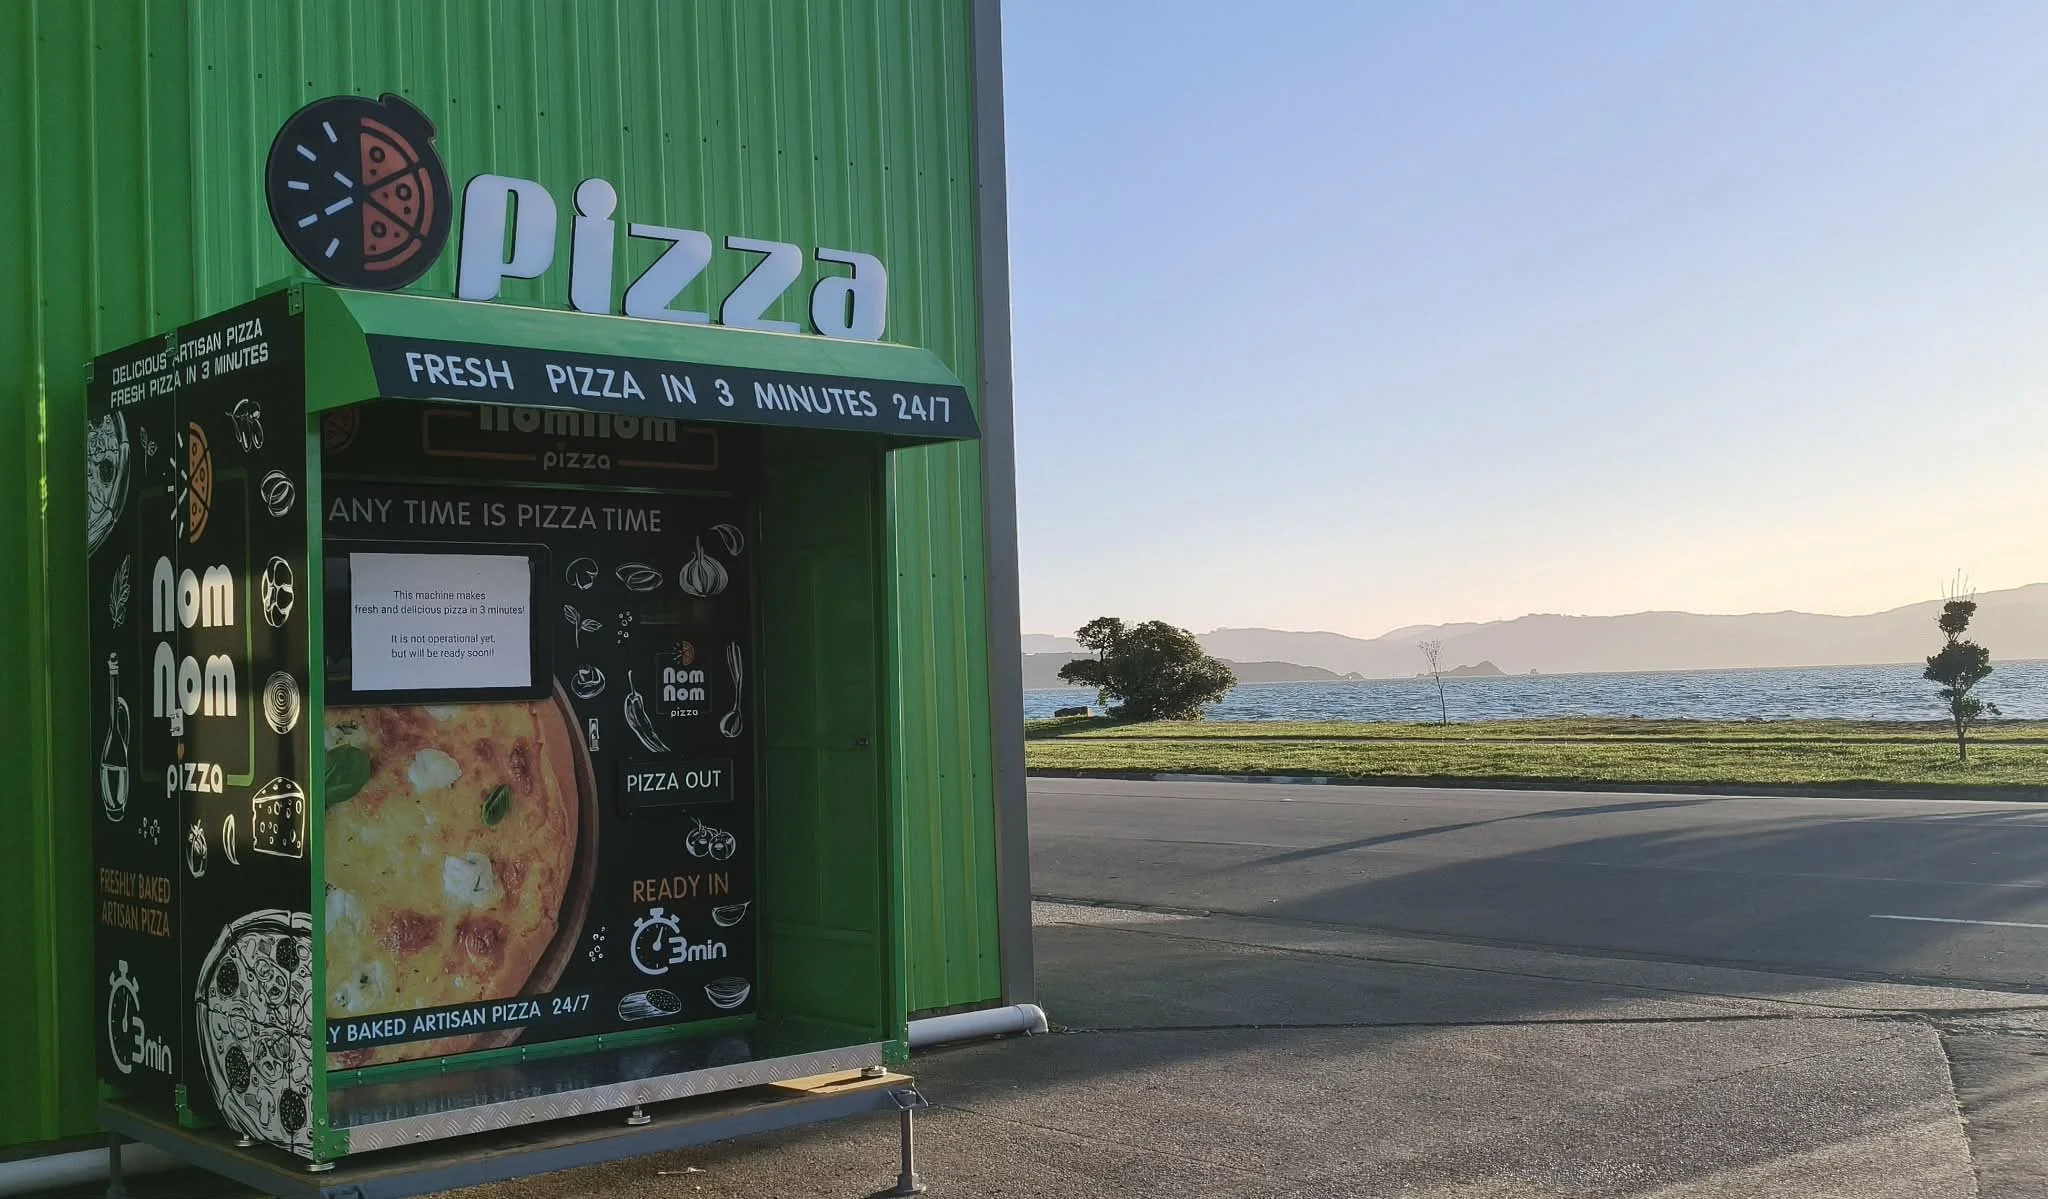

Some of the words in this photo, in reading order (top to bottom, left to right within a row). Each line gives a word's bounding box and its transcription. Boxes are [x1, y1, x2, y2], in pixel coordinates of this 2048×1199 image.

[454, 174, 887, 341] pizza
[112, 352, 167, 386] DELICIOUS
[226, 317, 263, 347] PIZZA
[111, 382, 146, 409] FRESH
[150, 369, 182, 398] PIZZA
[186, 364, 197, 385] IN
[201, 361, 210, 380] 3
[214, 341, 269, 377] MINUTES
[405, 351, 516, 391] FRESH
[545, 363, 645, 402] PIZZA
[661, 373, 698, 405] IN
[715, 378, 734, 408] 3
[754, 381, 878, 418] MINUTES
[892, 393, 951, 423] 24/7
[544, 450, 610, 471] pizza
[328, 497, 392, 523] ANY
[402, 499, 471, 527] TIME
[483, 502, 506, 528] IS
[517, 504, 598, 531] PIZZA
[600, 507, 662, 533] TIME
[354, 604, 379, 614] fresh
[381, 604, 398, 614] and
[400, 604, 442, 614] delicious
[444, 605, 467, 617] pizza
[470, 604, 478, 614] in
[479, 605, 486, 614] 3
[487, 605, 525, 615] minutes!
[393, 590, 413, 600] This
[415, 590, 454, 600] machine
[456, 590, 486, 600] makes
[391, 634, 398, 644] It
[400, 634, 408, 644] is
[410, 634, 426, 644] not
[427, 633, 478, 646] operational
[391, 649, 406, 659] but
[408, 649, 425, 658] will
[426, 649, 439, 658] be
[440, 649, 465, 660] ready
[670, 707, 699, 718] pizza
[167, 763, 223, 799] pizza
[627, 771, 679, 792] PIZZA
[685, 770, 722, 789] OUT
[100, 867, 136, 897] FRESHLY
[138, 873, 171, 904] BAKED
[632, 874, 700, 903] READY
[708, 871, 729, 896] IN
[102, 900, 138, 932] ARTISAN
[141, 907, 170, 937] PIZZA
[668, 936, 728, 964] 3min
[347, 1017, 406, 1043] BAKED
[412, 1007, 486, 1034] ARTISAN
[491, 1000, 541, 1023] PIZZA
[552, 994, 590, 1015] 24/7
[132, 1016, 173, 1075] 3min
